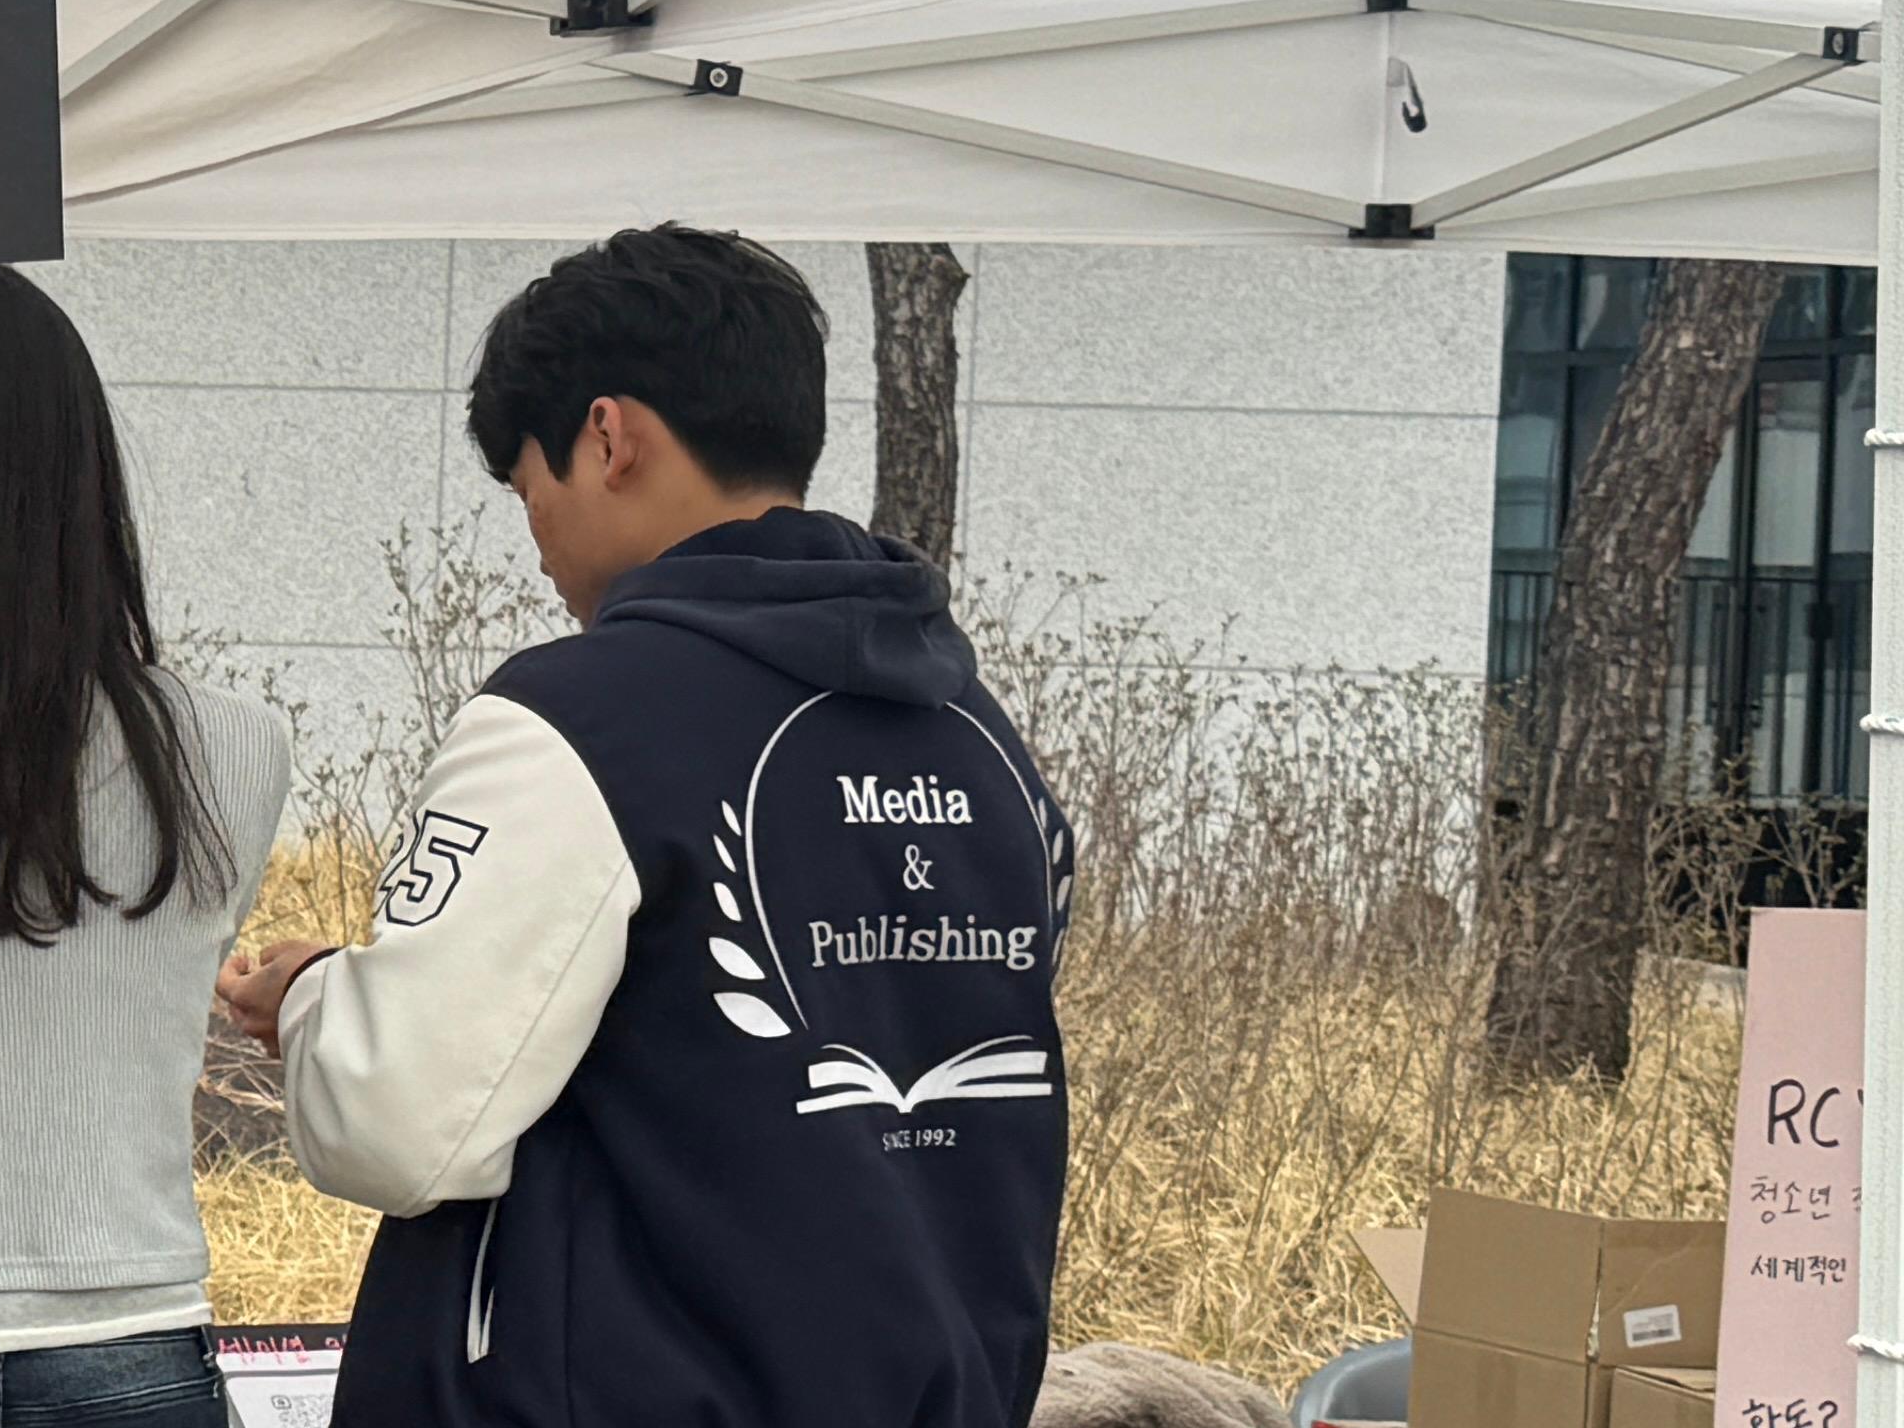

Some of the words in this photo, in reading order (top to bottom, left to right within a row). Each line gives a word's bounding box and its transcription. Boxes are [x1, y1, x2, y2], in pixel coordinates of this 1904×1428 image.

[837, 776, 974, 824] Media
[903, 844, 935, 891] &
[809, 916, 1036, 971] Publishing
[1767, 1078, 1864, 1148] RC
[915, 1128, 957, 1147] 1992
[1750, 1175, 1831, 1224] 청소년
[1750, 1255, 1847, 1285] 세계적인
